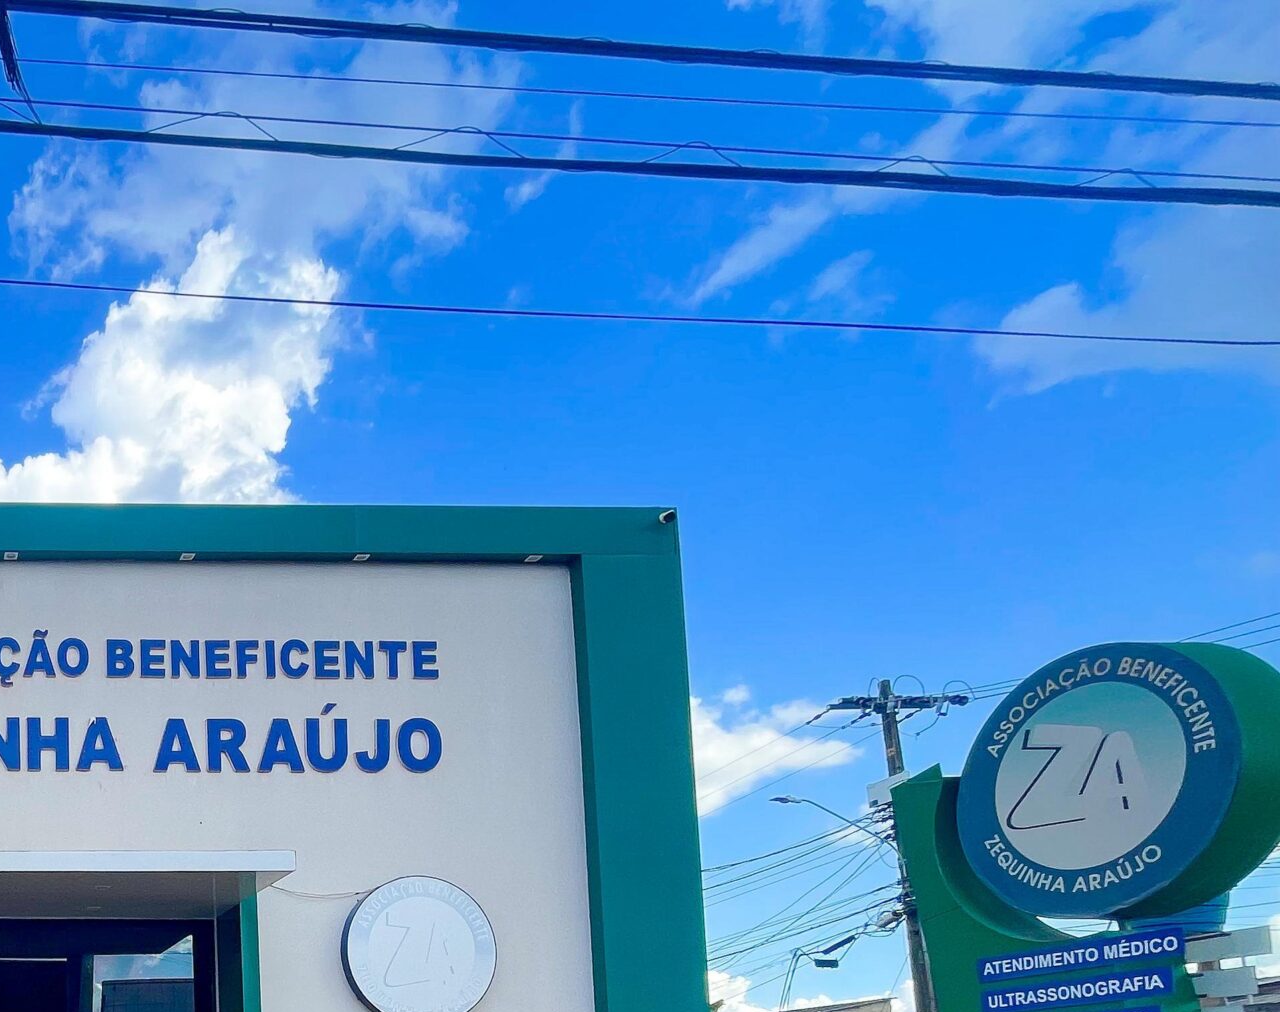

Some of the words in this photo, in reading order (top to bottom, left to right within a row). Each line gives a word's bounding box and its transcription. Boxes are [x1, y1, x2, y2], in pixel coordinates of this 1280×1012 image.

[106, 639, 441, 680] BENEFICENTE
[986, 657, 1111, 758] ASSOCIAÇÃO
[1117, 656, 1217, 754] BENEFICENTE
[153, 703, 443, 775] ARAÚJO
[983, 834, 1066, 894] ZEQUINHA
[1071, 844, 1163, 893] ARAÚJO
[983, 946, 1100, 976] ATENDIMENTO
[1103, 935, 1179, 960] MÉDICO
[987, 973, 1165, 1009] ULTRASSONOGRAFIA
